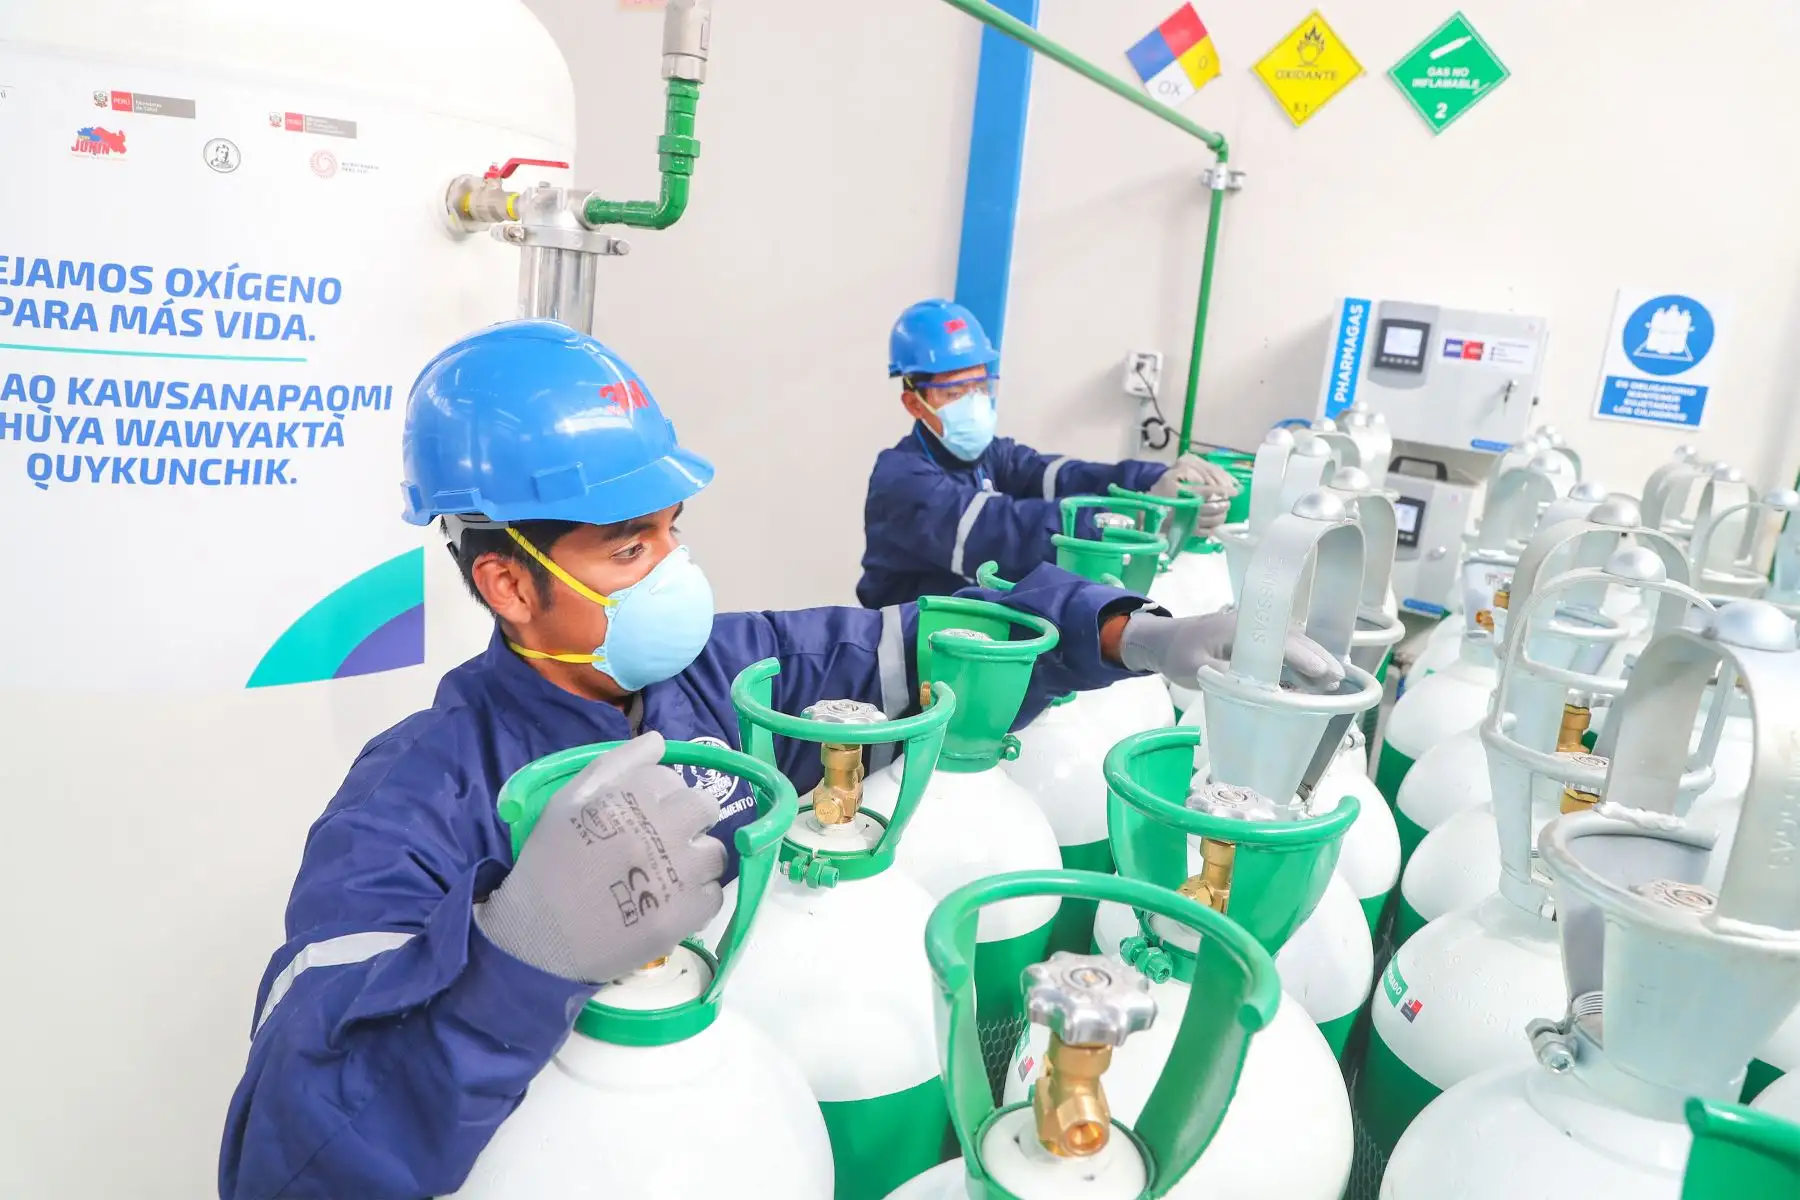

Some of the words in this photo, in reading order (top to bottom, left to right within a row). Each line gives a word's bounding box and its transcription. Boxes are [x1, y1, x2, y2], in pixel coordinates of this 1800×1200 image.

[1275, 69, 1338, 81] OXIDANTE
[1411, 77, 1481, 91] INFLAMABLE
[1426, 65, 1451, 78] GAS
[1452, 66, 1471, 78] NO
[1157, 80, 1183, 96] OX
[1434, 101, 1449, 120] 2
[166, 262, 342, 305] OXÍGENO
[0, 296, 99, 332] PARA
[109, 298, 204, 338] MÁS
[215, 311, 316, 341] VIDA.
[1333, 303, 1364, 403] PHARMAGAS
[67, 378, 393, 420] KAWSANAPAQMI
[115, 418, 345, 449] WAWYAKTA
[26, 452, 298, 491] QUYKUNCHIK.
